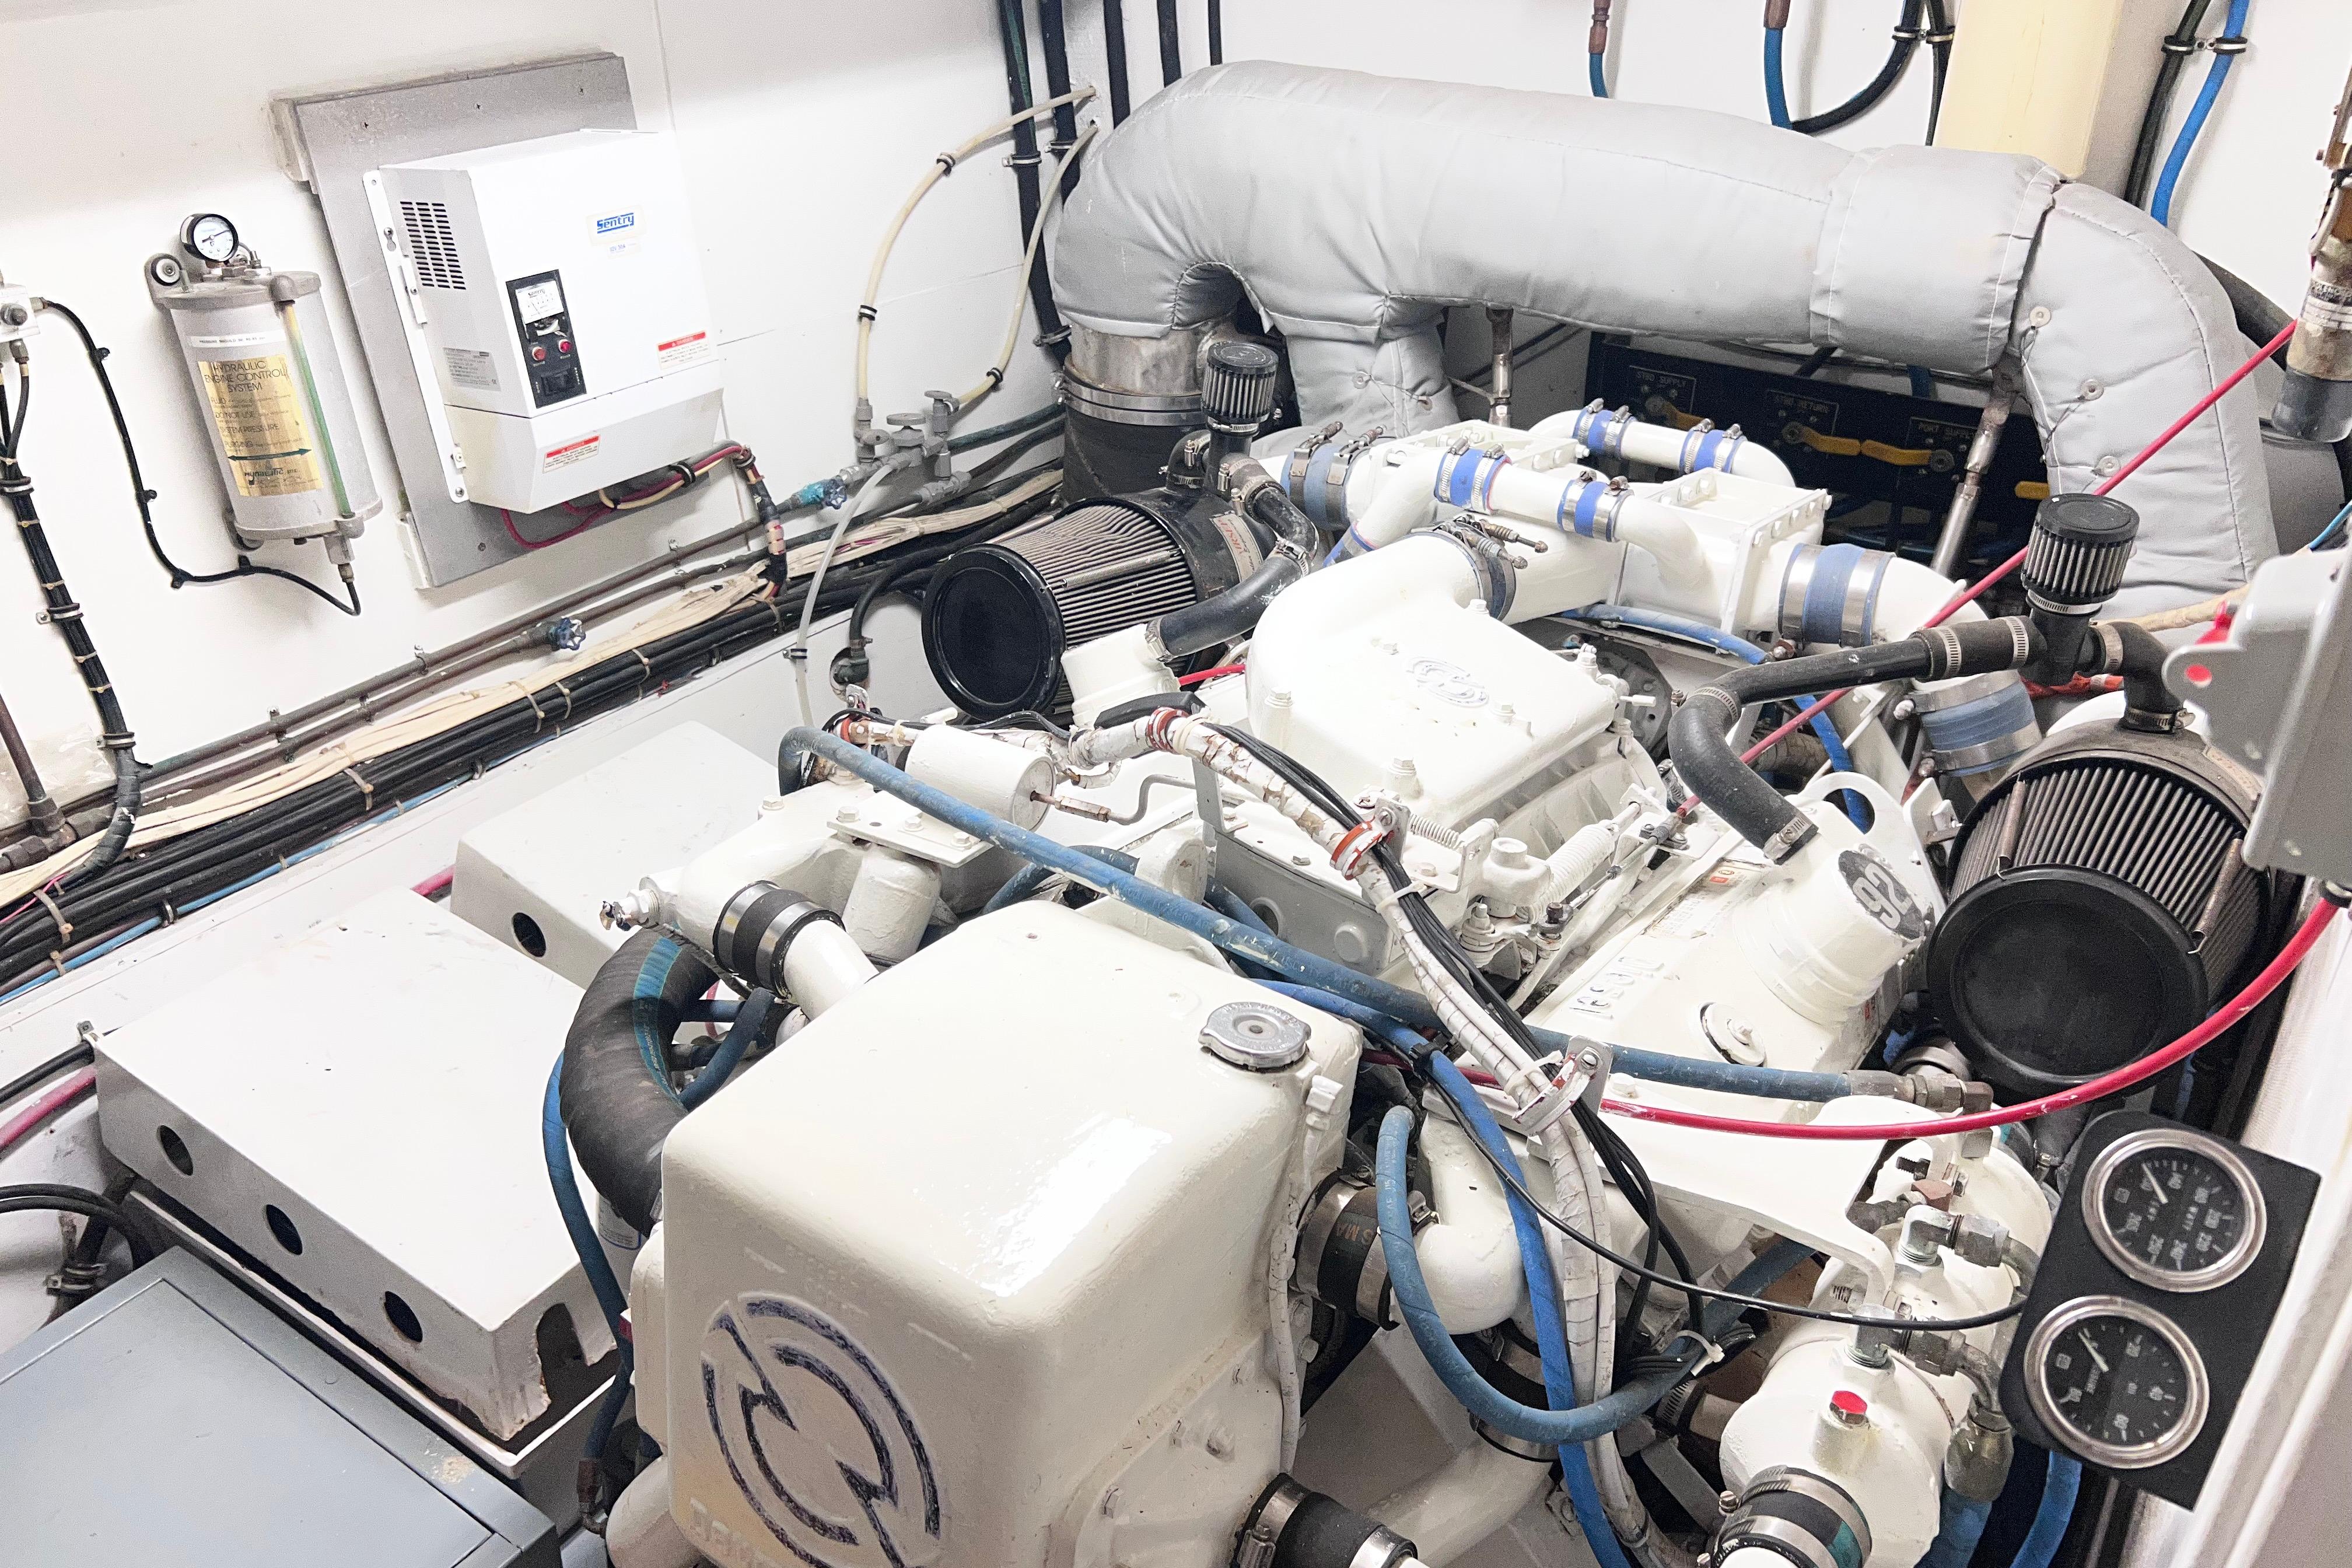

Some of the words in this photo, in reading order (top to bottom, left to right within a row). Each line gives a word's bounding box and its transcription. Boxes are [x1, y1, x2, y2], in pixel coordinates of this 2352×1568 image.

[597, 212, 634, 233] Sentry
[212, 360, 267, 372] HYDRAULIC
[204, 373, 235, 384] ENGINE
[235, 368, 286, 382] CONTROL
[227, 382, 263, 393] SYSTEM
[1852, 862, 1913, 929] 92
